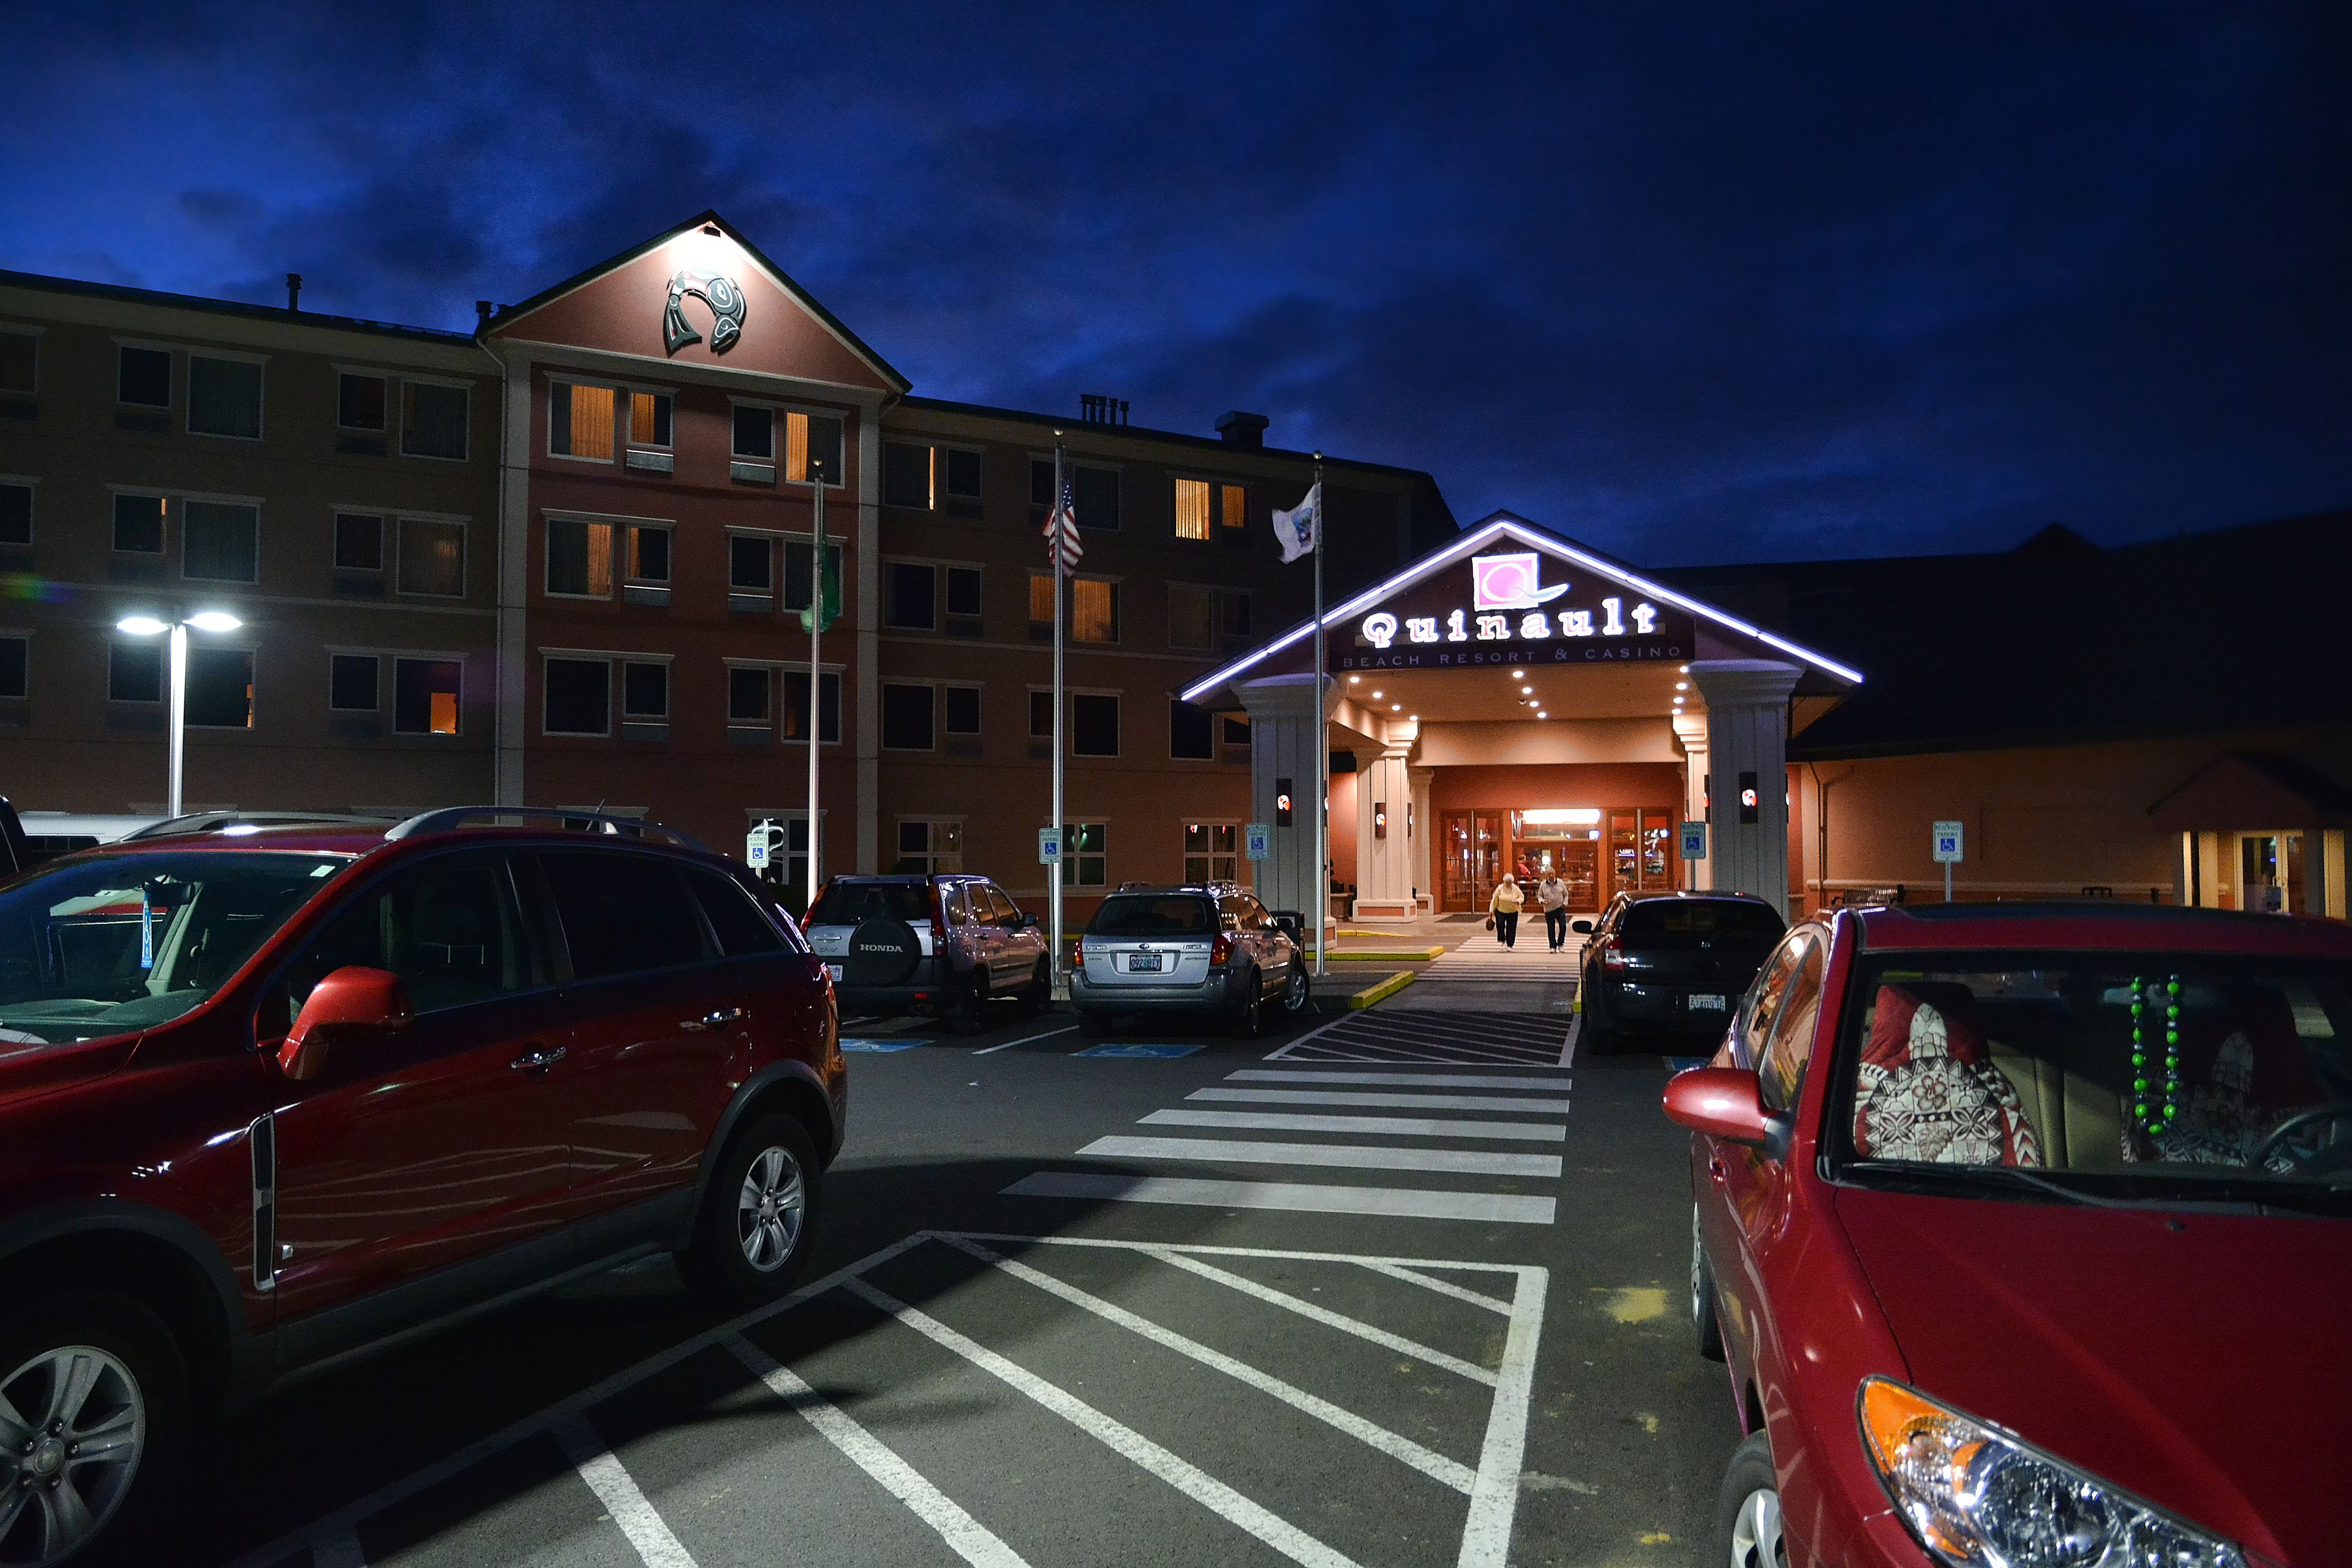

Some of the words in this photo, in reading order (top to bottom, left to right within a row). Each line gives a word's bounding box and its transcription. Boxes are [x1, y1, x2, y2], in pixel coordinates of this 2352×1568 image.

[1362, 598, 1656, 649] Quinault
[1343, 655, 1419, 668] BEACH
[1440, 651, 1535, 664] RESORT
[1555, 648, 1567, 660] &
[1585, 646, 1680, 660] CASINO
[859, 944, 903, 953] HONDA
